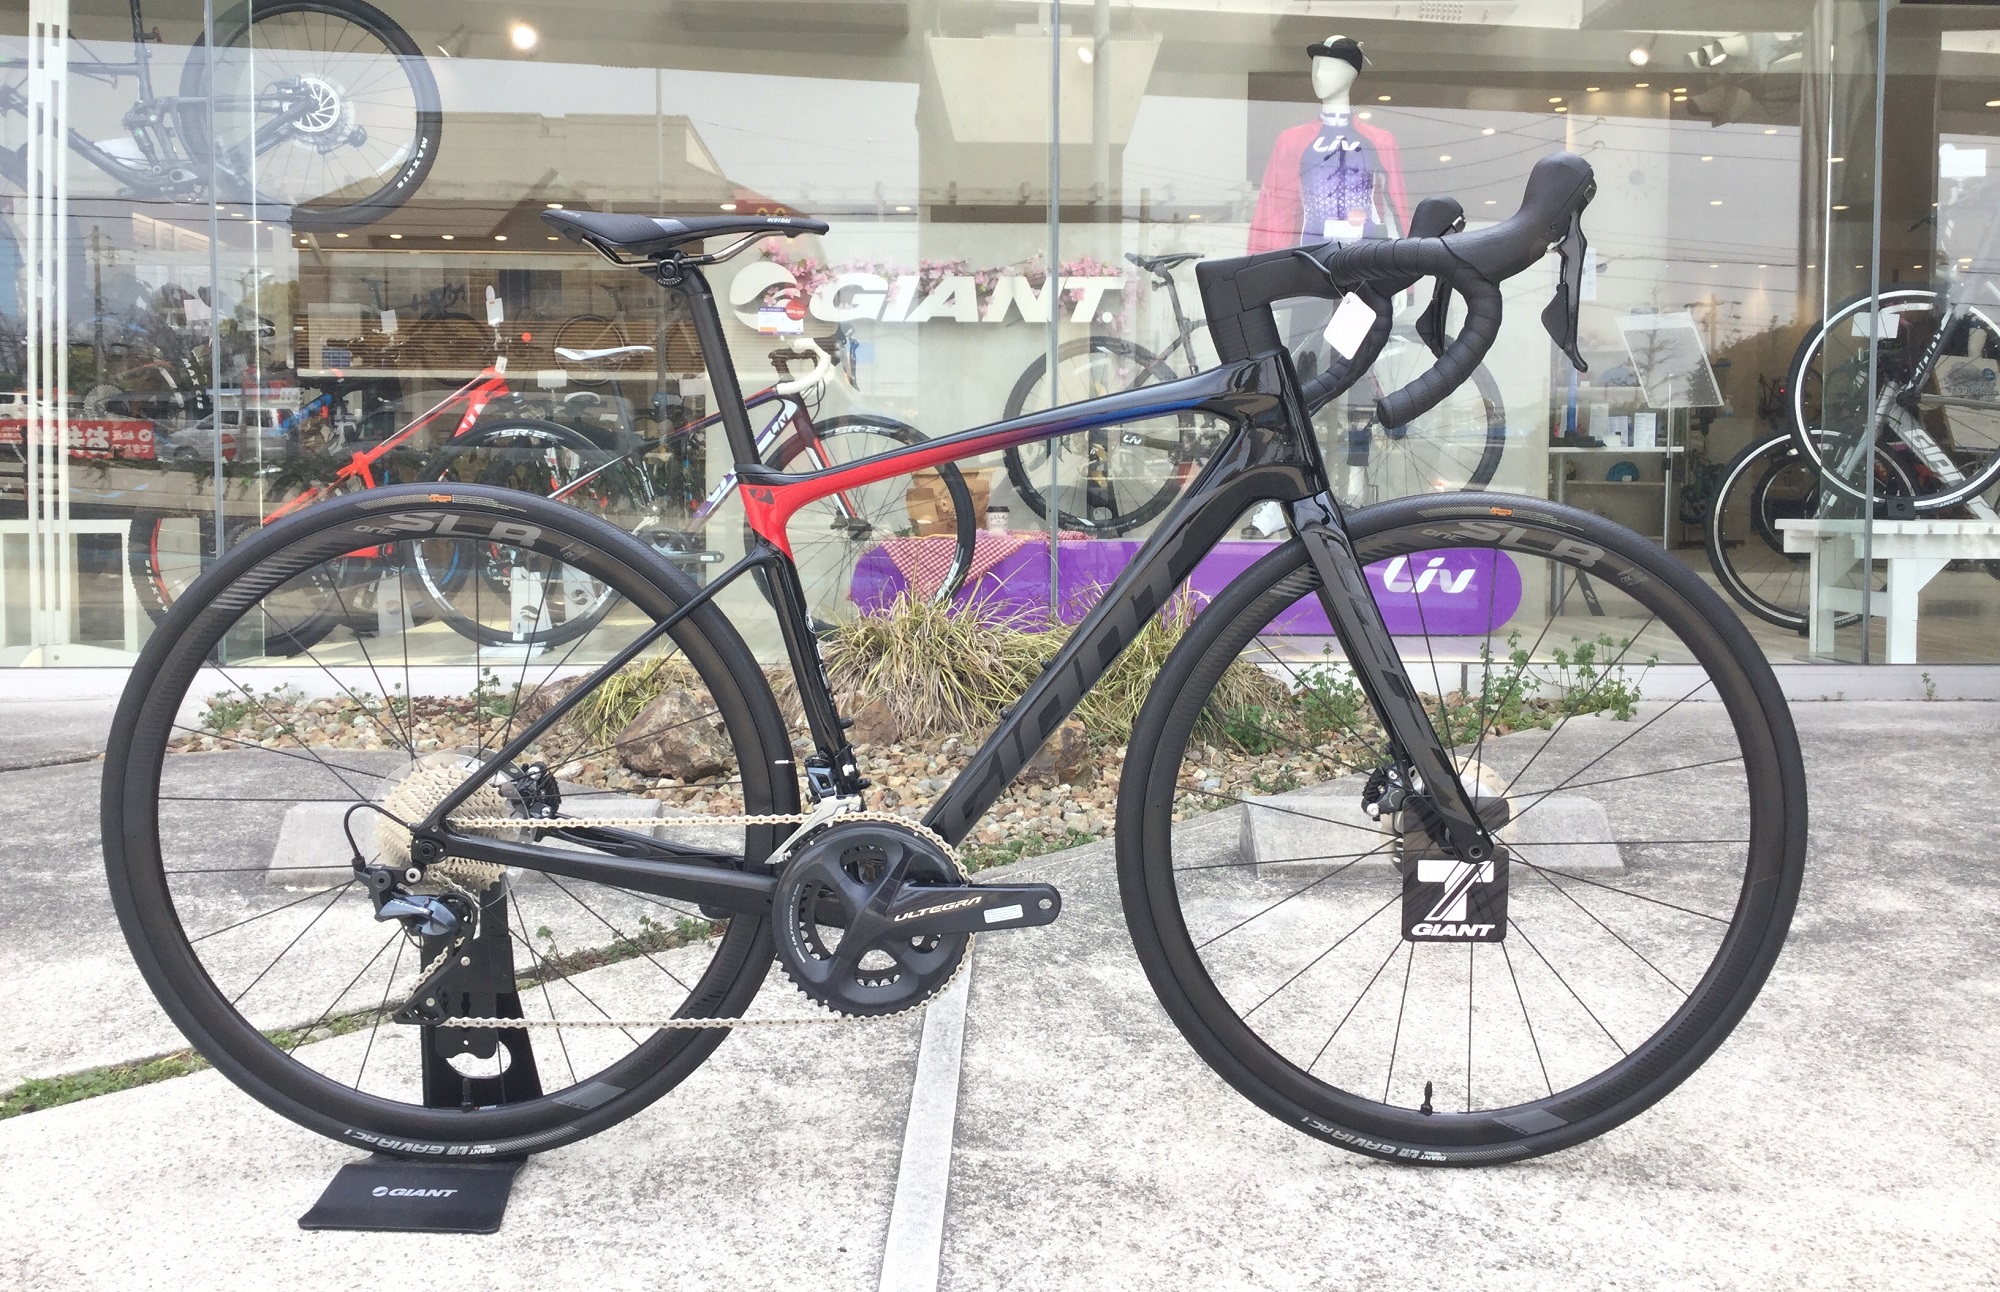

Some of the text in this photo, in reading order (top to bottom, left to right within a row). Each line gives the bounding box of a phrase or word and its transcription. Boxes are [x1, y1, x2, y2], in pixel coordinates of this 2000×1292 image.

[397, 136, 428, 189] MAXXIS
[388, 512, 542, 547] SLR
[1458, 521, 1605, 568] SLR
[893, 896, 983, 923] ULTEGRA
[1411, 923, 1496, 937] GIANT
[468, 1147, 496, 1155] GIANT
[388, 1188, 458, 1198] GIANT
